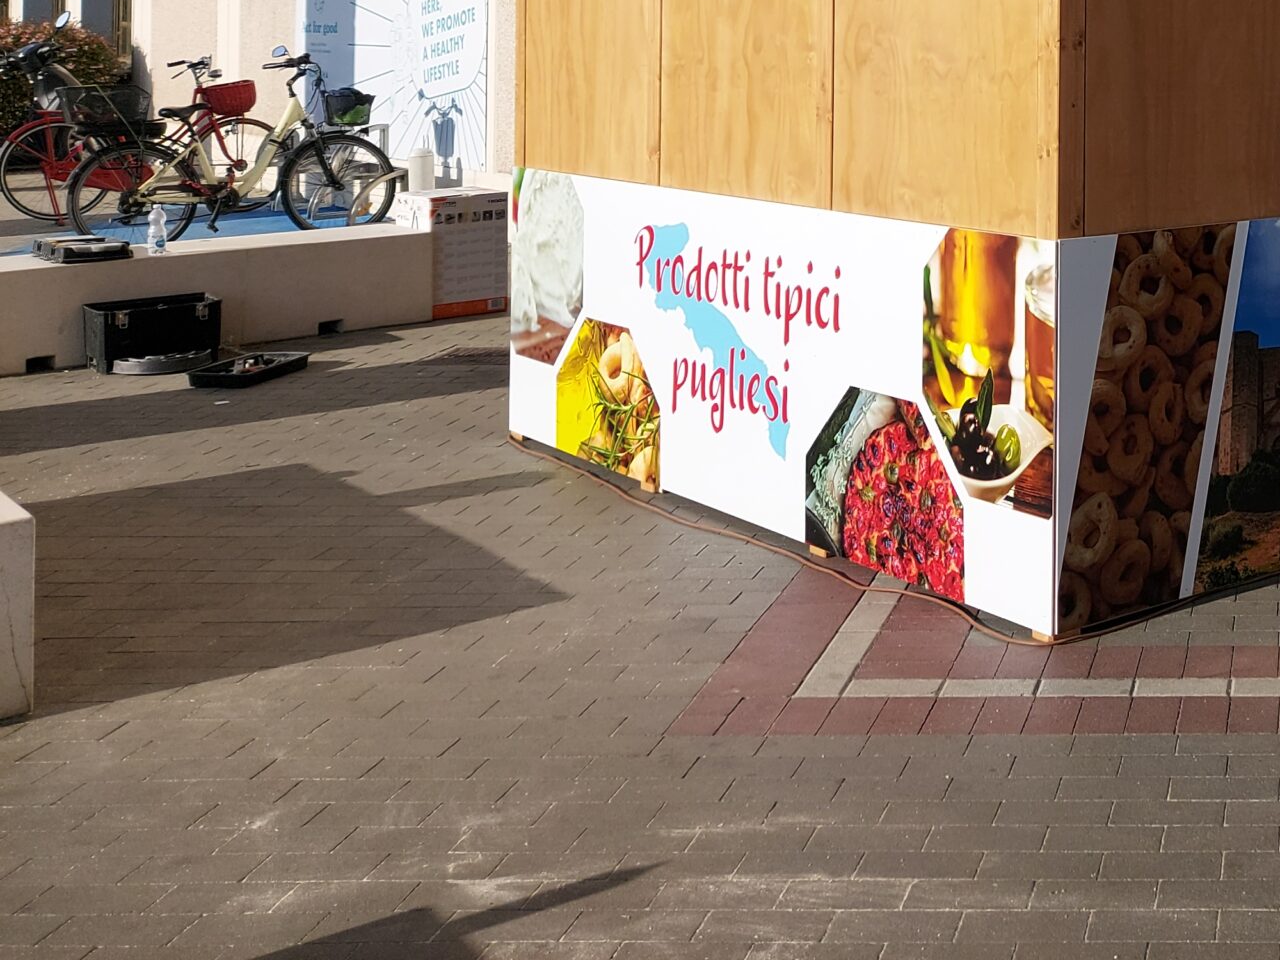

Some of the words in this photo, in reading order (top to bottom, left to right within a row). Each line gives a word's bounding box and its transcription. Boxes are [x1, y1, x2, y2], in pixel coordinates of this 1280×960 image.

[323, 22, 338, 37] good
[421, 21, 434, 38] WE
[436, 7, 475, 34] PROMOTE
[422, 46, 429, 61] A
[430, 33, 465, 59] HEALTHY
[423, 59, 460, 83] LIFESTYLE
[634, 224, 751, 312] Prodotti
[762, 256, 841, 346] tipici
[671, 347, 790, 433] pugliesi
